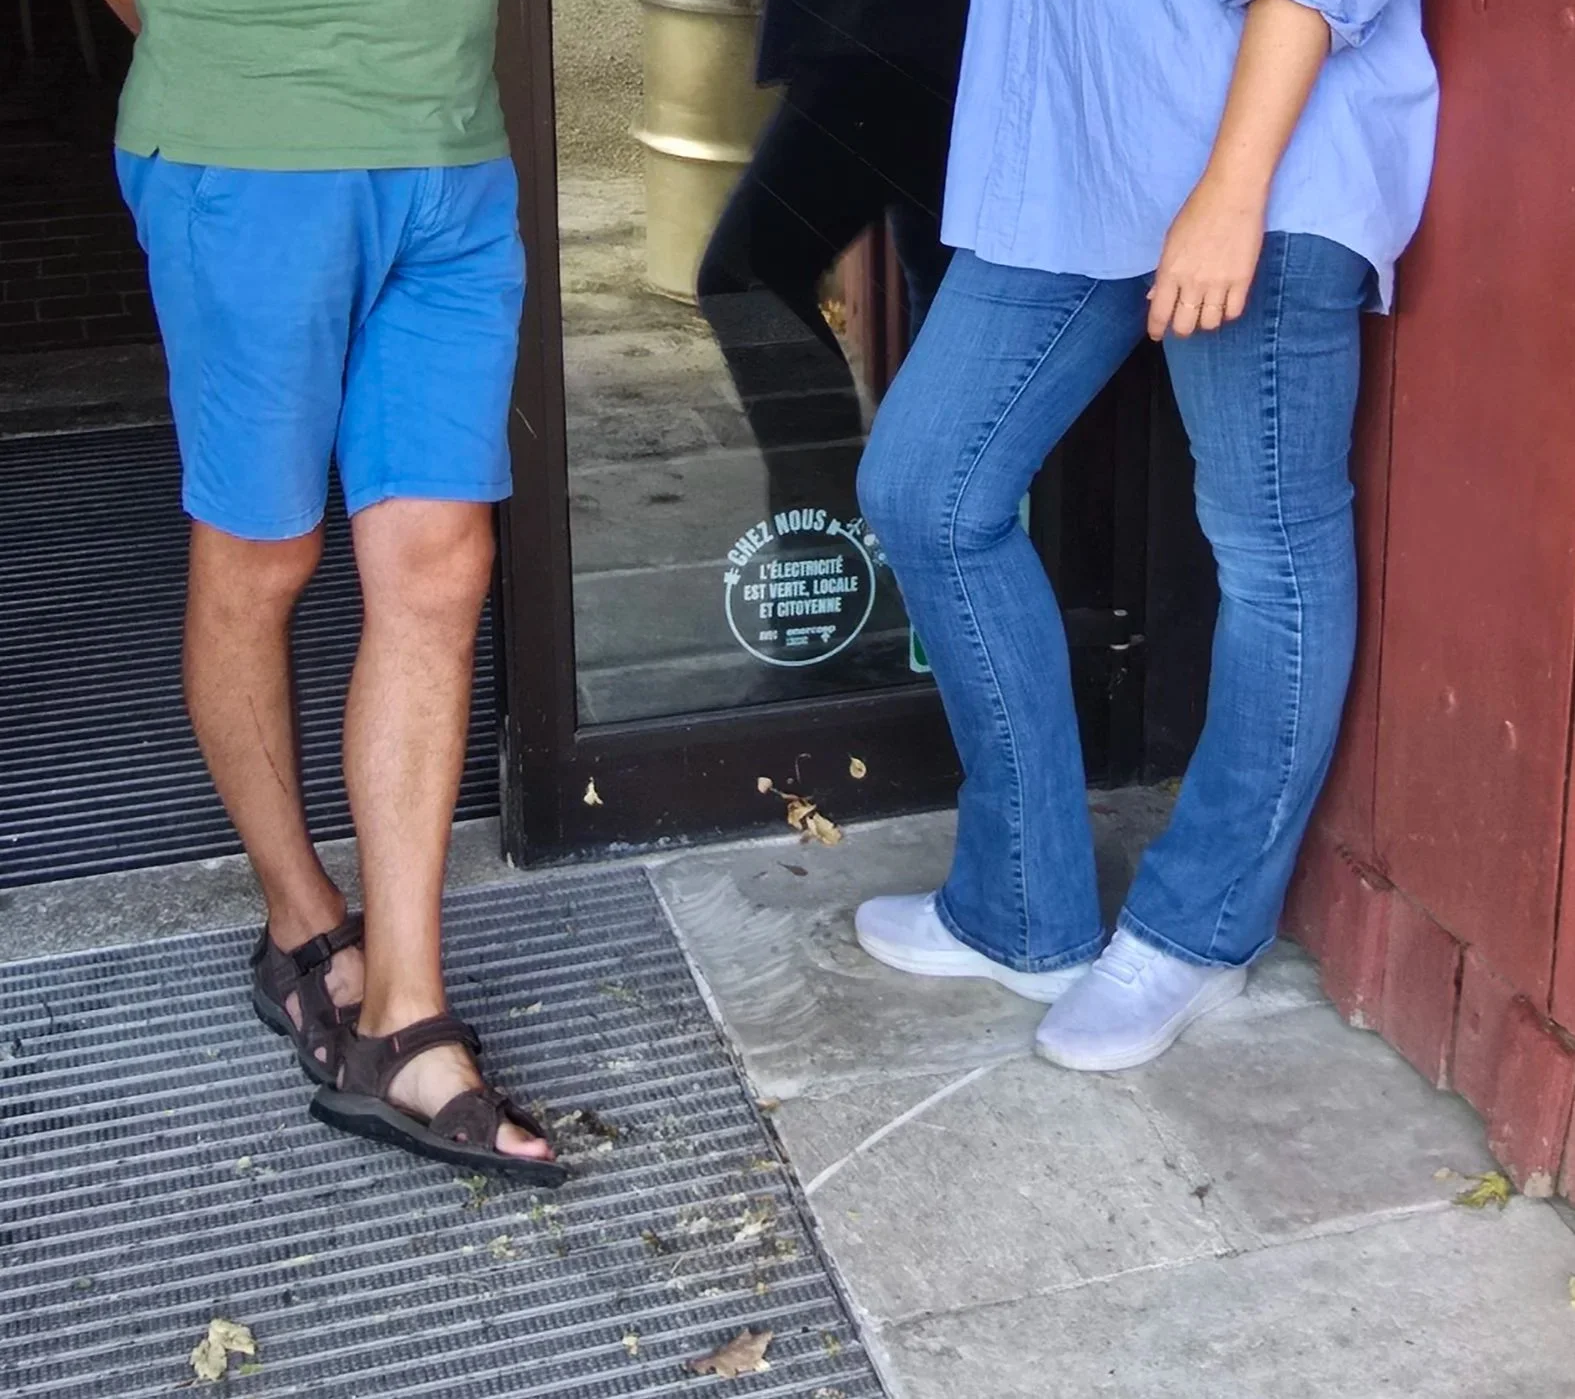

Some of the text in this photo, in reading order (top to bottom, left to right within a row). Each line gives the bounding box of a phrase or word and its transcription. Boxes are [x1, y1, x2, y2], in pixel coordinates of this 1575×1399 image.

[727, 508, 828, 567] CHEZ NOUS
[759, 554, 844, 580] L'ÉLECTRICITÉ
[743, 576, 859, 601] EST VERTE, LOCALE
[759, 597, 842, 619] ET CITOYENNE
